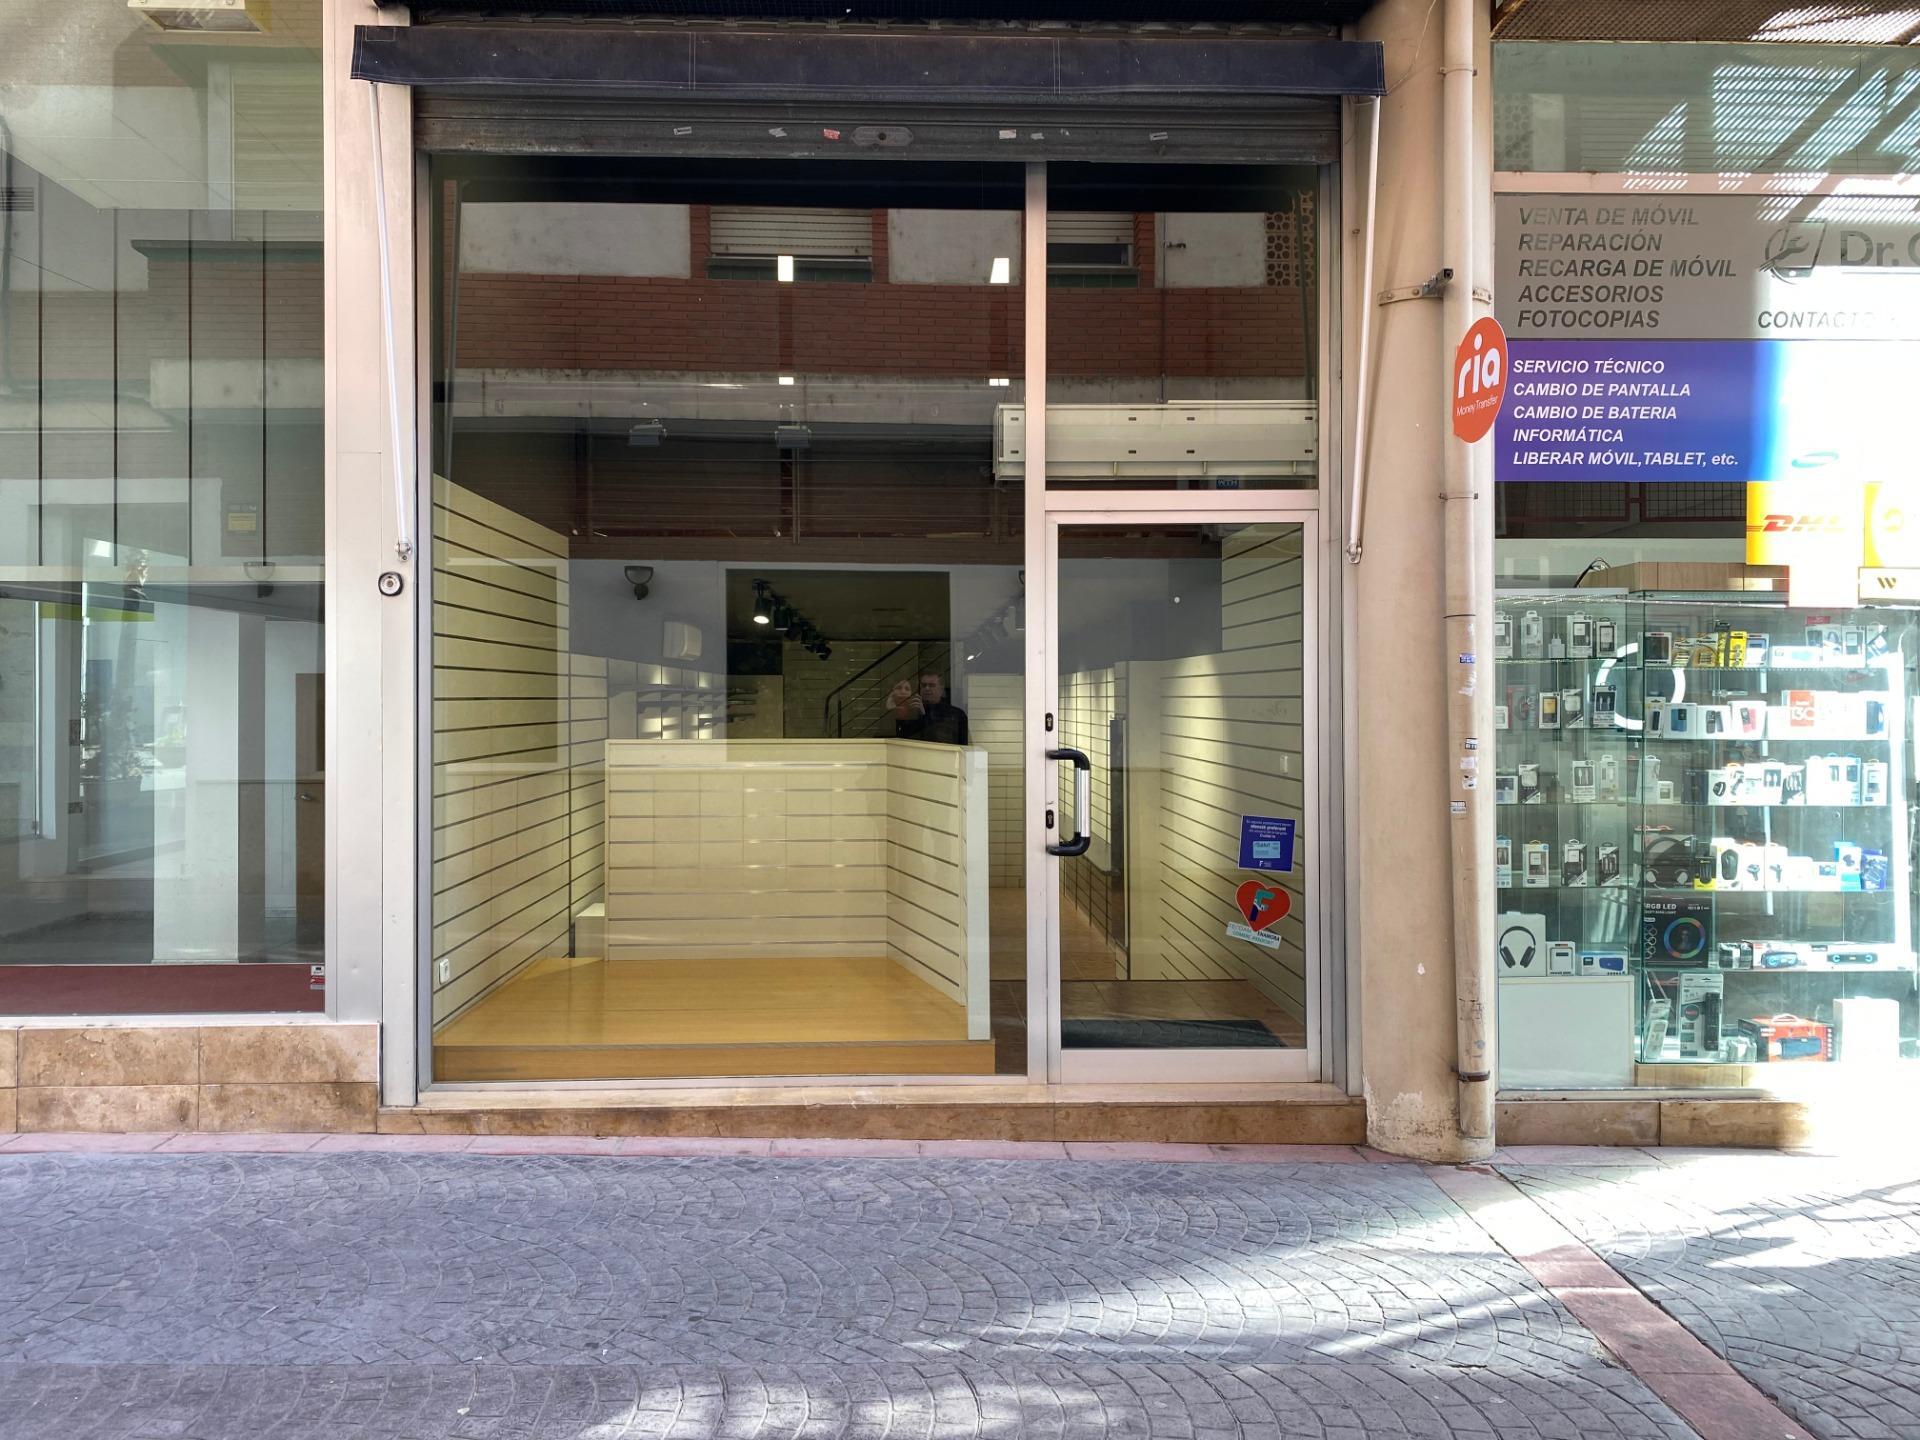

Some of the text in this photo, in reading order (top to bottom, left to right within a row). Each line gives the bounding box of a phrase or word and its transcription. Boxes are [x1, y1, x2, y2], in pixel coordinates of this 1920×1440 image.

[1518, 203, 1699, 225] VENTA DE MÓVIL
[1518, 229, 1663, 251] REPARACIÓN
[1518, 255, 1737, 277] RECARGA DE MÓVIL
[1517, 285, 1664, 303] ACCESORIOS
[1517, 310, 1661, 328] FOTOCOPIAS
[1457, 332, 1501, 399] ria
[1513, 357, 1665, 374] SERVICIO TÉCNICO
[1513, 383, 1691, 397] CAMBIO DE PANTALLA
[1456, 395, 1499, 417] Money Transfer
[1513, 406, 1677, 419] CAMBIO DE BATERIA
[1513, 426, 1624, 442] INFORMÁTICA
[1513, 452, 1584, 465] LIBERAR
[1711, 453, 1739, 465] etc.
